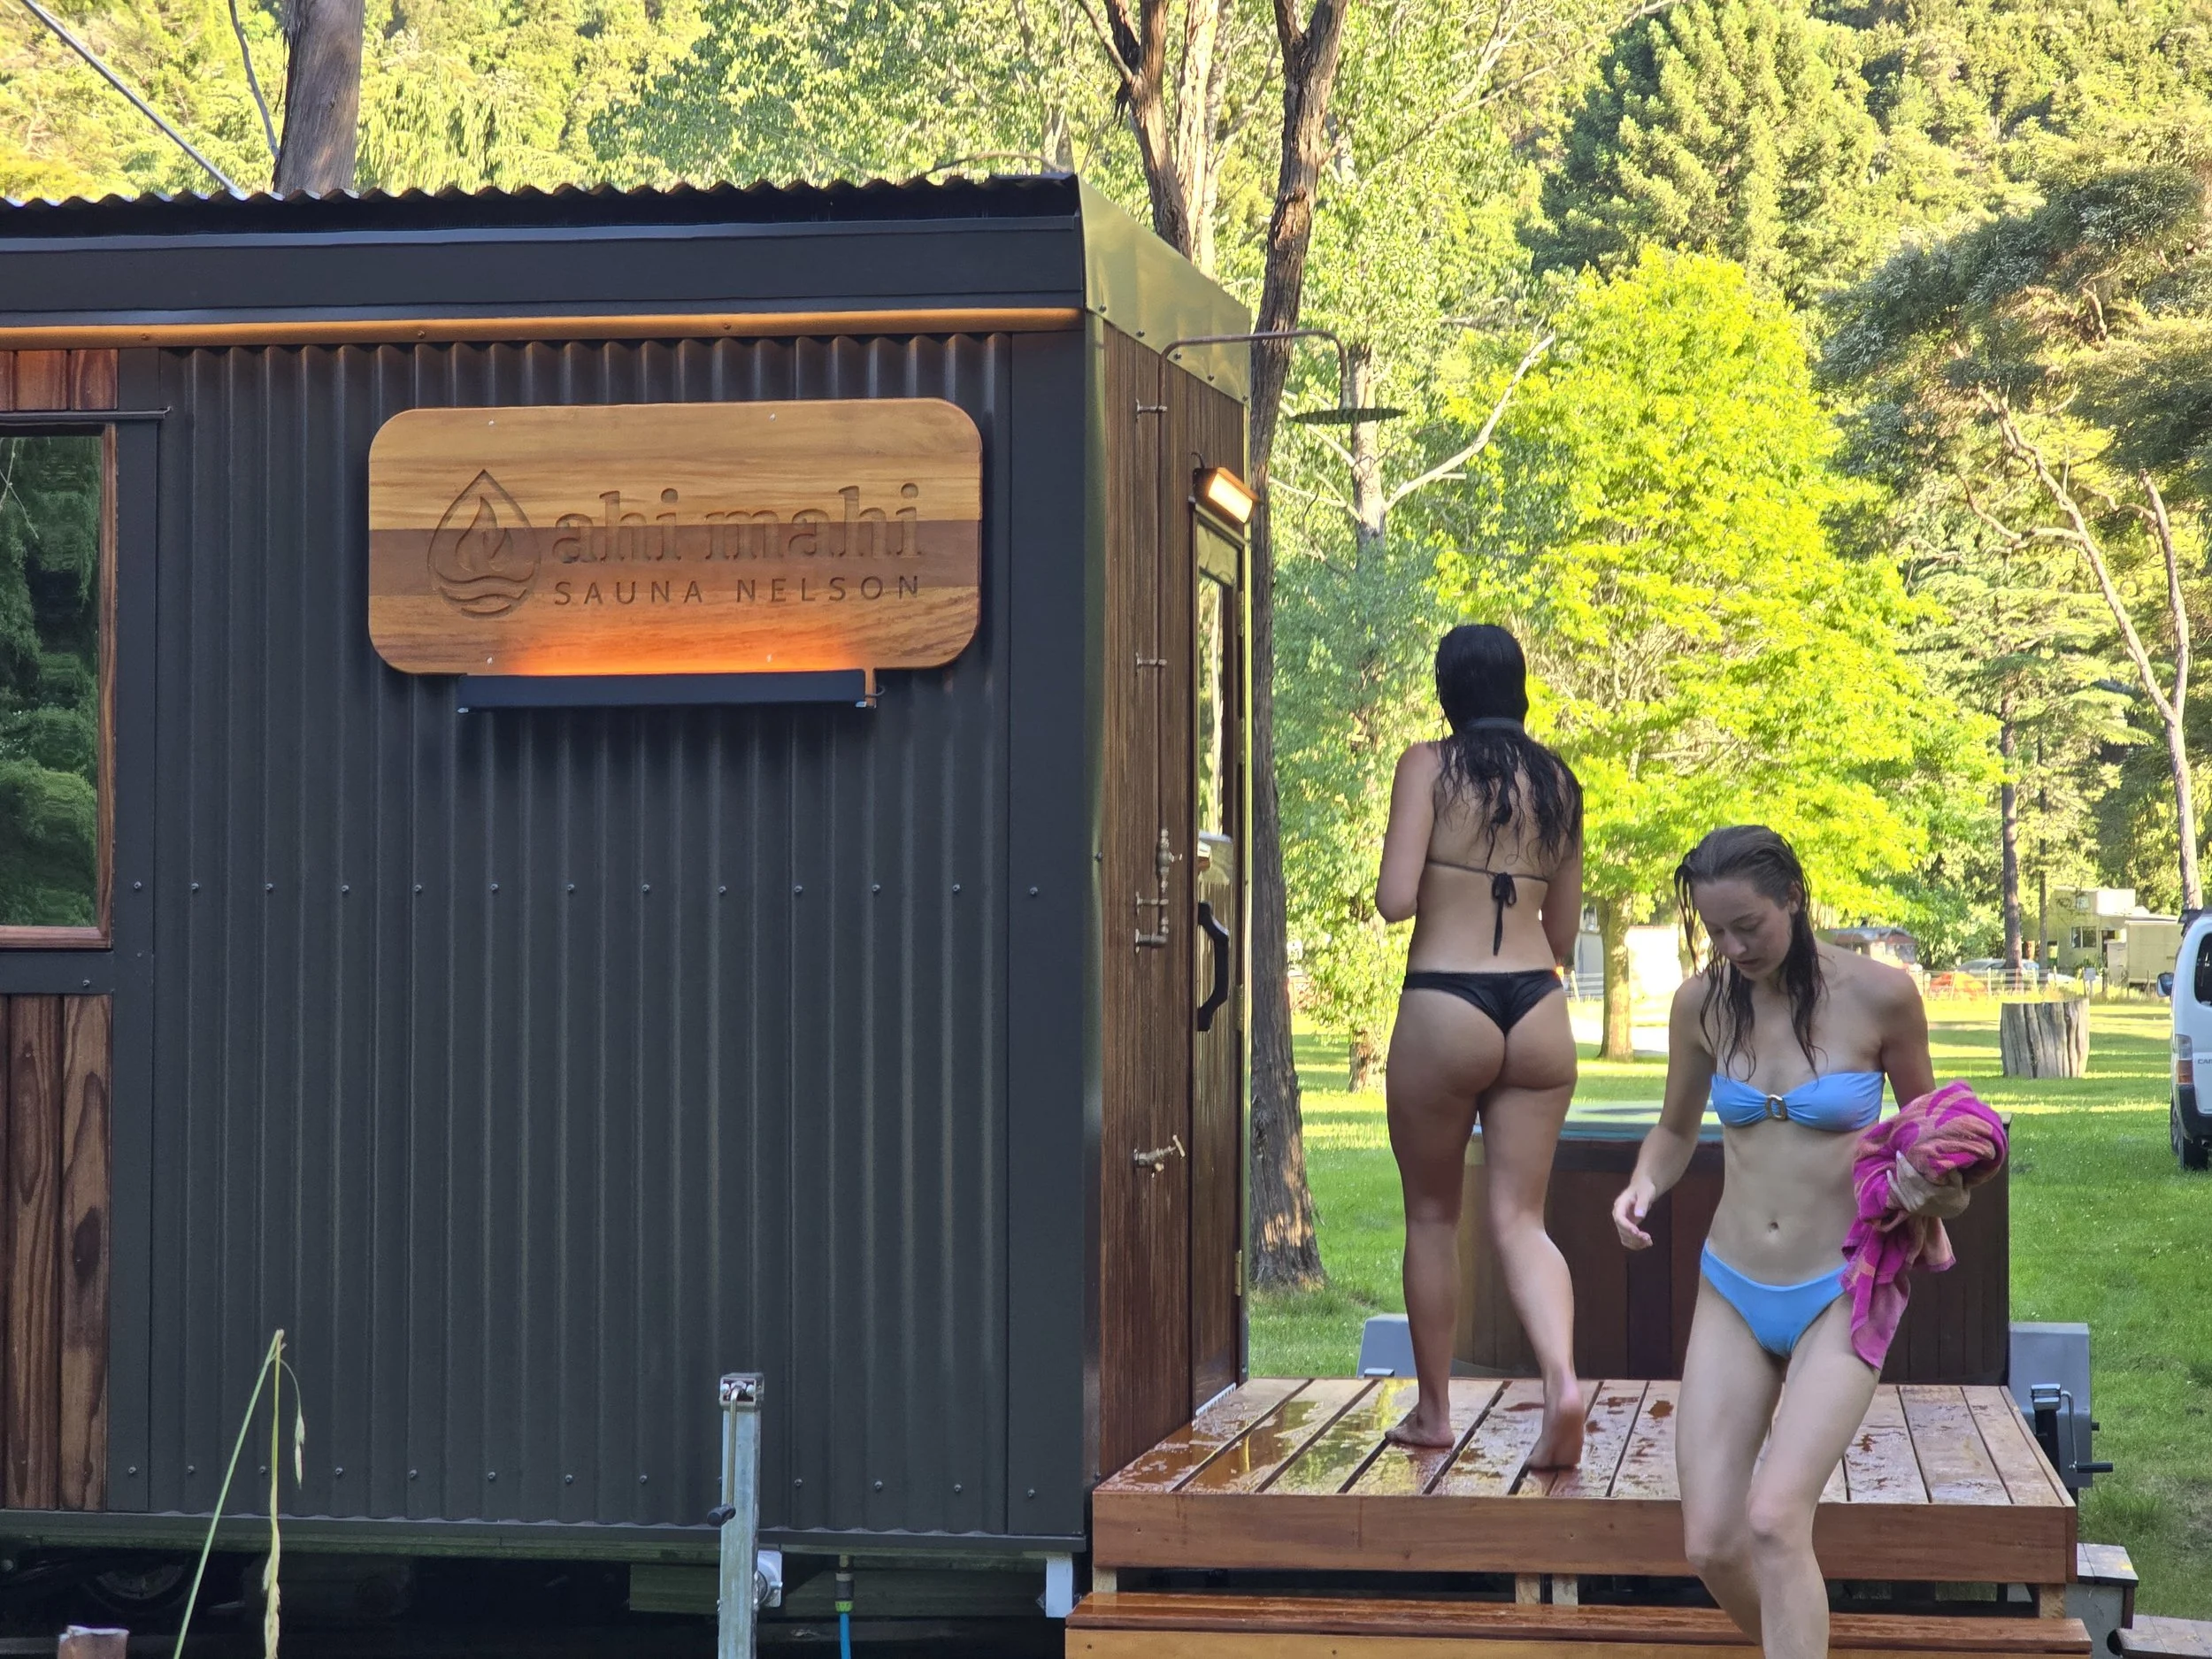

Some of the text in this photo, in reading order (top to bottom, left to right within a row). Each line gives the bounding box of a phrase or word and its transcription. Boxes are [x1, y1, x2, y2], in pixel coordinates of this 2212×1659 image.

[552, 482, 922, 564] ahi mahi
[554, 575, 918, 605] SAUNA NELSON
